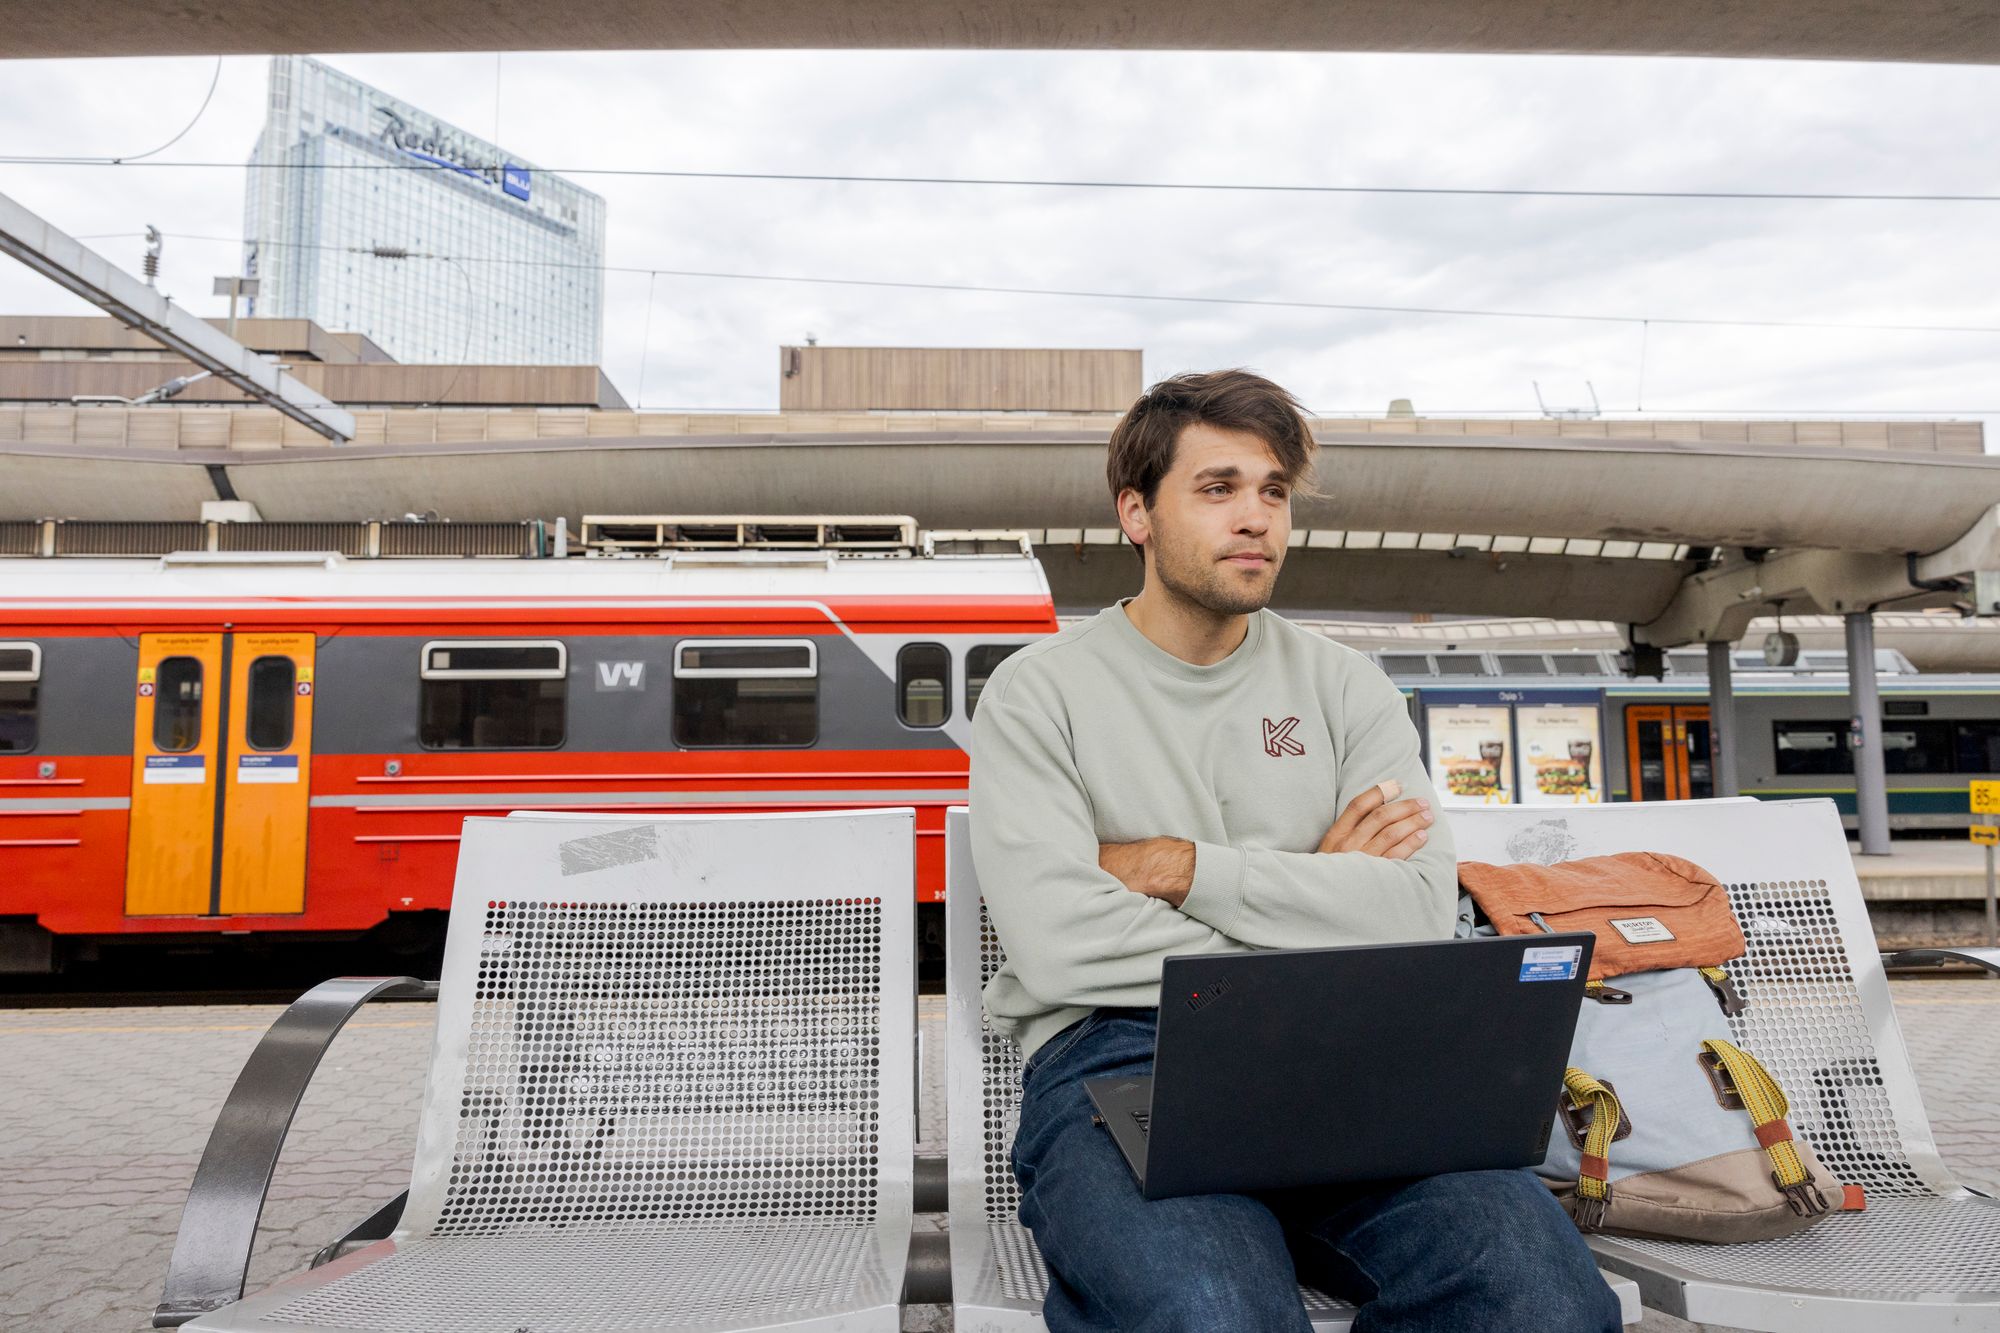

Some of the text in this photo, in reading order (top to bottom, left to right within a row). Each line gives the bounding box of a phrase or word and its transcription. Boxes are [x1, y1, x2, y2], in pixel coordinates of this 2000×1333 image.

[375, 106, 500, 185] Radisson
[1262, 716, 1305, 757] K
[1621, 920, 1655, 928] BURTON
